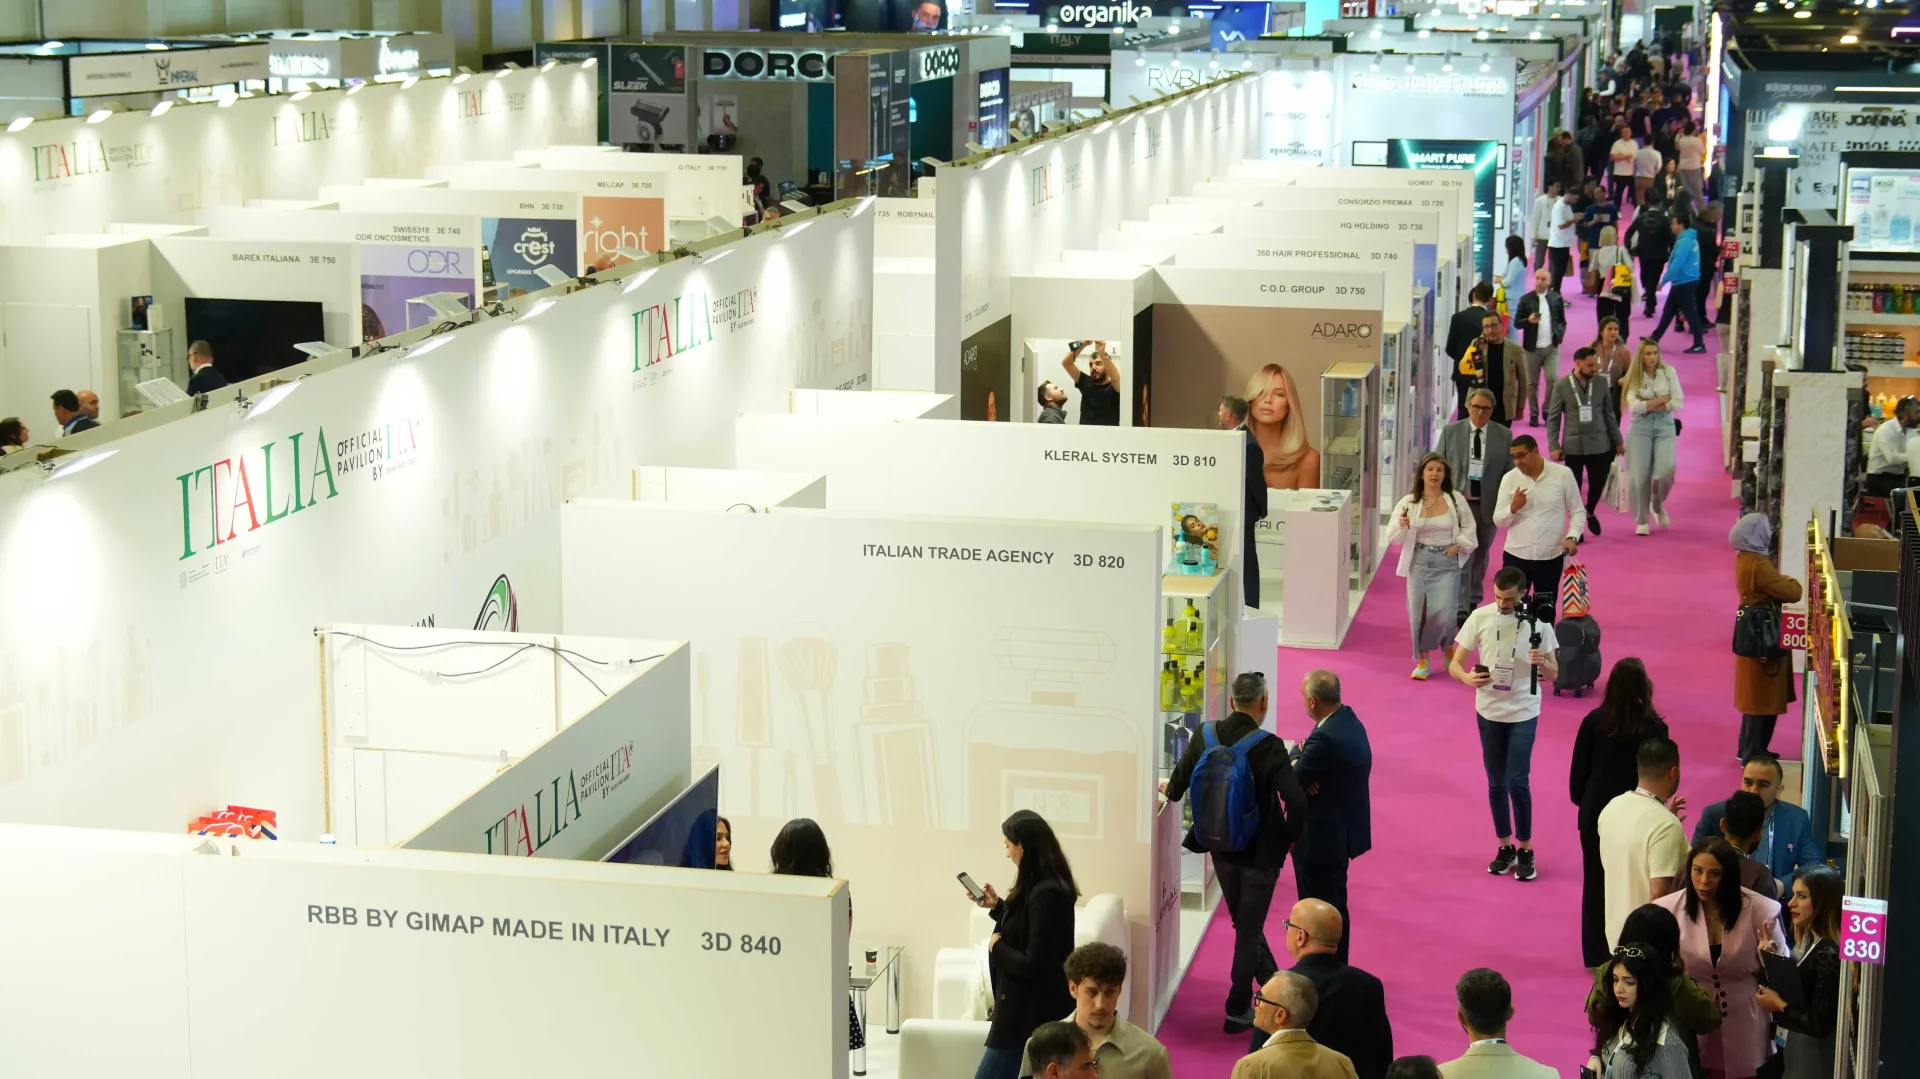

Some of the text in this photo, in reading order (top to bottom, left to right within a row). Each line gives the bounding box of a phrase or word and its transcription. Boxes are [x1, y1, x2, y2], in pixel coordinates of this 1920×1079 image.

[1060, 2, 1152, 27] organika
[1050, 34, 1082, 46] ITALY
[703, 51, 835, 78] DORC
[613, 81, 648, 91] SLEEK
[272, 111, 330, 146] IALIA
[1846, 114, 1907, 127] JOANNA
[1032, 162, 1064, 206] ITALA
[551, 203, 564, 211] 730
[1338, 198, 1381, 206] CONSORZIO
[393, 226, 461, 235] SWISS318 3E 740
[1340, 222, 1423, 231] HQ HOLDING 3D 730
[356, 233, 430, 243] ODR ONCOSMETICS
[513, 239, 555, 255] crest
[1257, 249, 1398, 260] 360 HAIR PROFESSIONAL 3D 740
[232, 254, 336, 264] BAREX ITALIANA 3E 750
[407, 250, 463, 275] ODR
[1260, 284, 1365, 295] C.O.D. GROUP 3D 750
[713, 296, 737, 313] OFFICIAL
[713, 308, 737, 325] PAVILION
[632, 288, 713, 372] ITALIA
[1311, 322, 1372, 339] ADARO
[337, 428, 382, 457] OFFICIAL
[337, 446, 383, 477] PAVILION
[1044, 450, 1216, 467] KLERAL SYSTEM 3D 810
[372, 464, 383, 481] BY
[176, 425, 339, 560] ITALIA
[863, 544, 1125, 569] ITALIAN TRADE AGENCY 3D 820
[1782, 633, 1807, 648] 800
[580, 758, 610, 787] OFFICIAL
[580, 771, 610, 802] PAVILION
[602, 786, 610, 799] BY
[484, 743, 631, 857] ITALIA ITA
[307, 904, 783, 957] RBB BY GIMAP MADE IN ITALY 3D 840
[1848, 914, 1878, 935] 3C
[1843, 938, 1881, 960] 830
